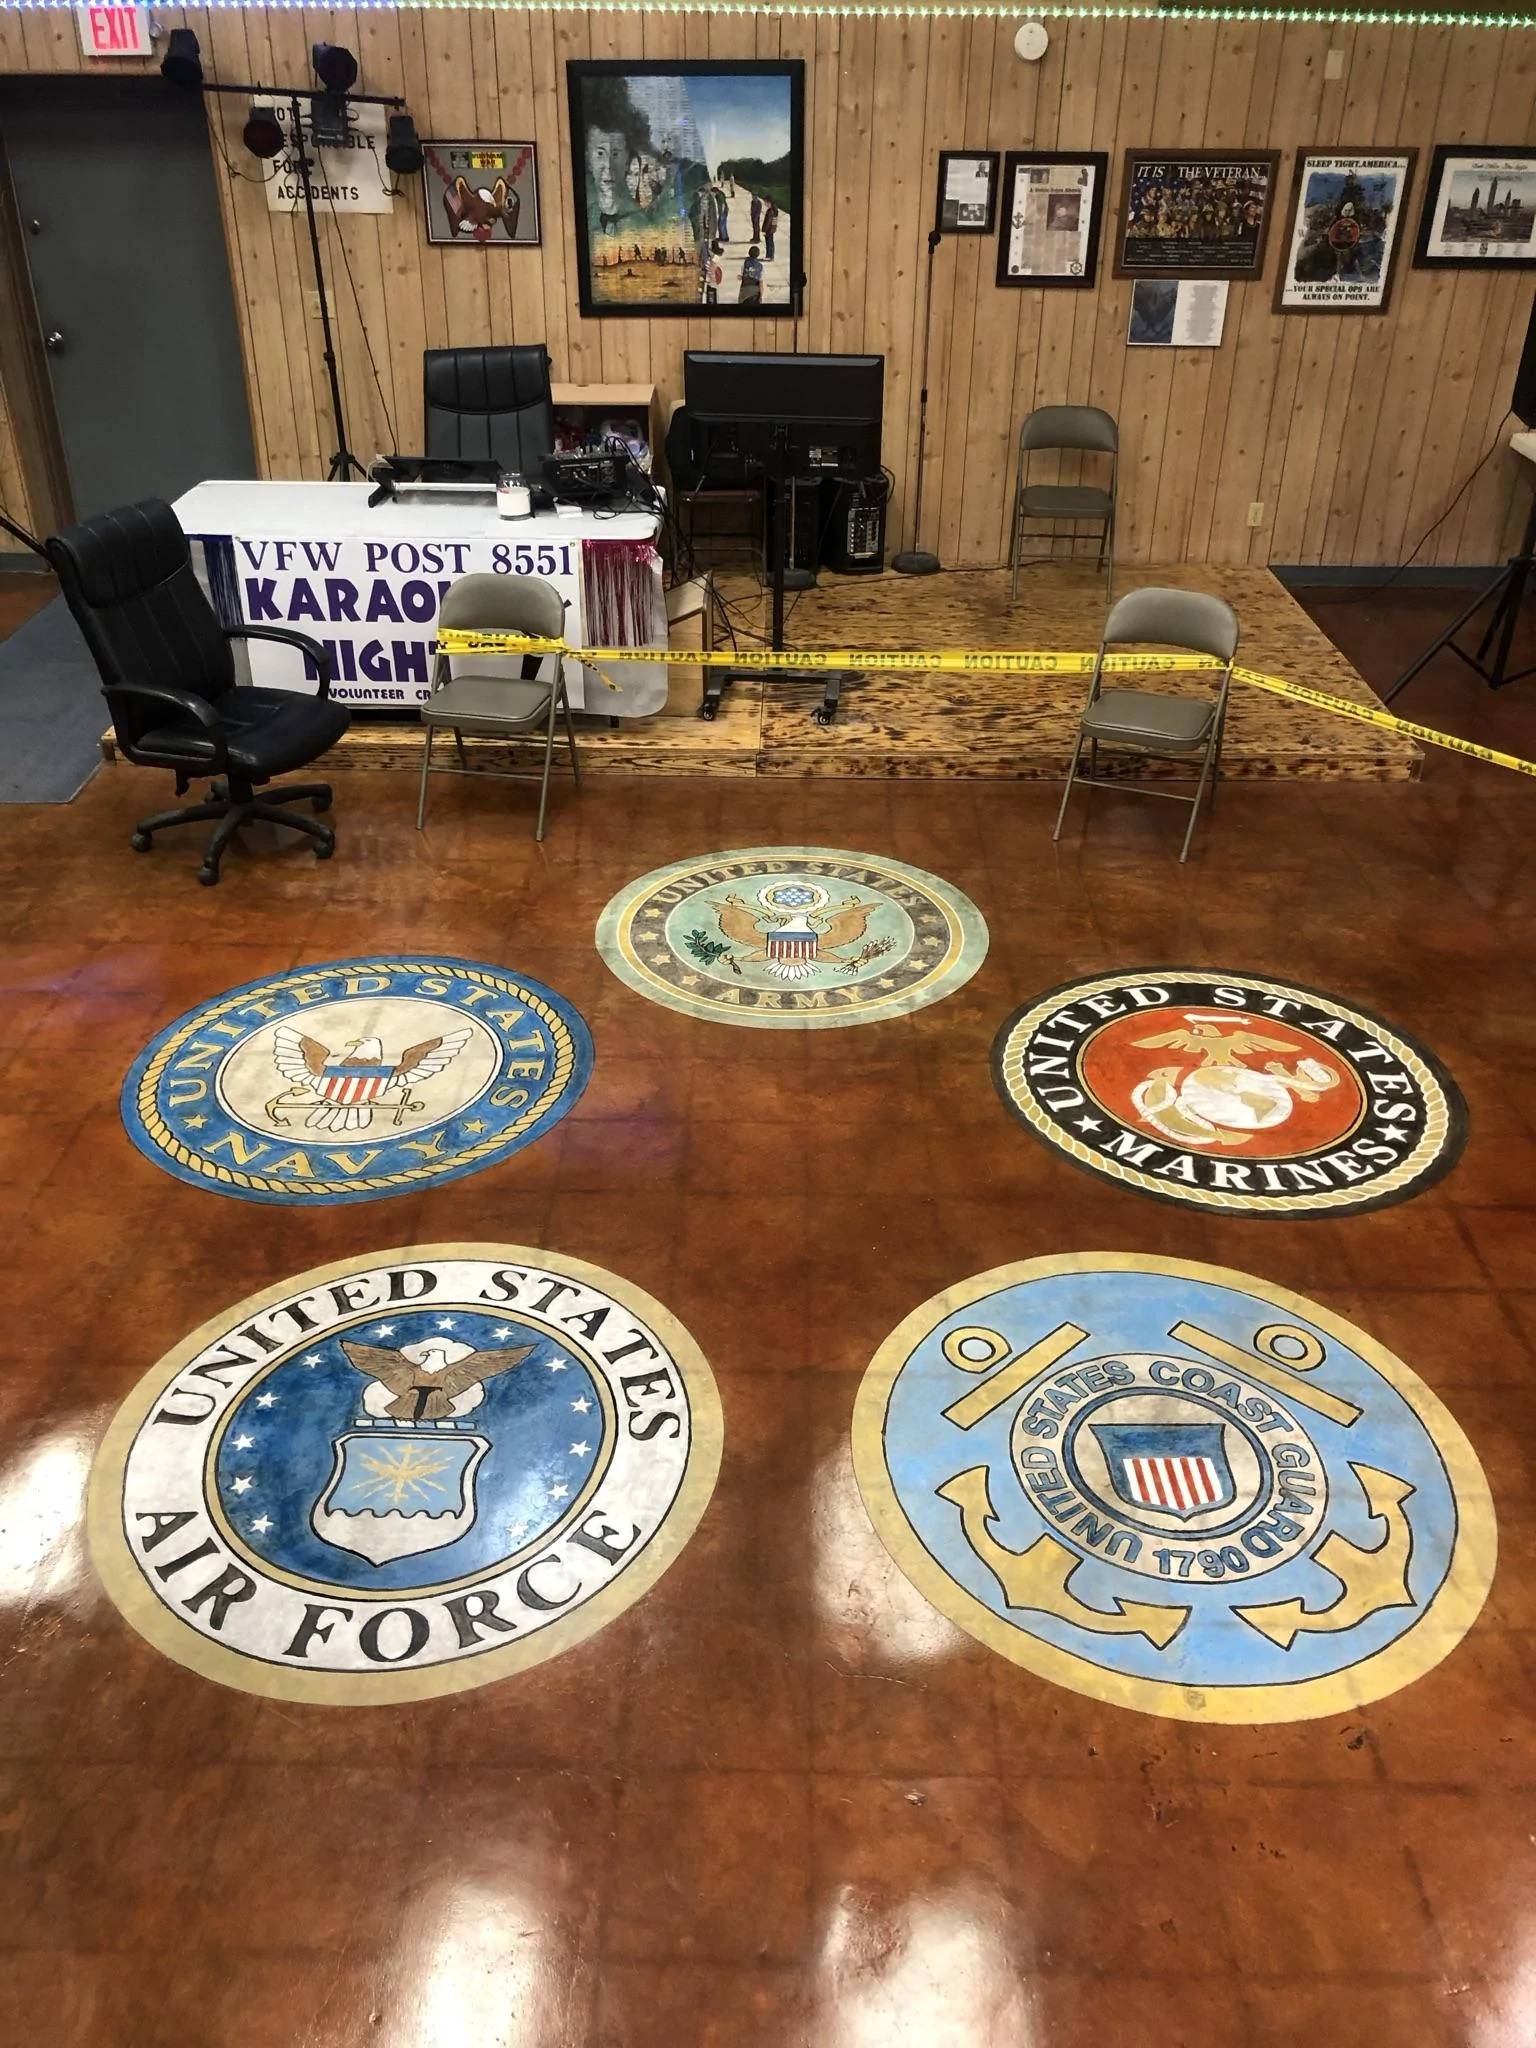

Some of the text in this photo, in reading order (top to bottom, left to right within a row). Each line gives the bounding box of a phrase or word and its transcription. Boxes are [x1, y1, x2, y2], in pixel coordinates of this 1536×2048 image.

[88, 8, 140, 49] EXIT
[1137, 167, 1152, 178] IT
[1152, 166, 1166, 178] IS
[1178, 166, 1202, 179] THE
[1306, 160, 1333, 168] SLEEP
[277, 186, 360, 200] ACCDENTS
[1302, 293, 1331, 301] ALWAYS
[1332, 293, 1343, 301] ON
[1314, 285, 1346, 293] SPECIAL
[1347, 285, 1363, 294] OPS
[241, 540, 574, 576] VFW POST 8551
[245, 577, 571, 624] KARAO
[328, 688, 405, 700] VOLUNTEER
[654, 860, 930, 908] UNITED STATES
[713, 986, 865, 1010] ARMY
[167, 975, 545, 1109] UNITED STATES
[1029, 985, 1416, 1125] UNITED STATES
[203, 1129, 450, 1178] NAVY
[1100, 1128, 1399, 1192] MARINES
[153, 1267, 682, 1443] UNITED STATES
[1020, 1359, 1318, 1564] UNITED STATES COAST GUARD
[1151, 1545, 1251, 1579] 1790
[134, 1508, 643, 1665] AIR FORCE
